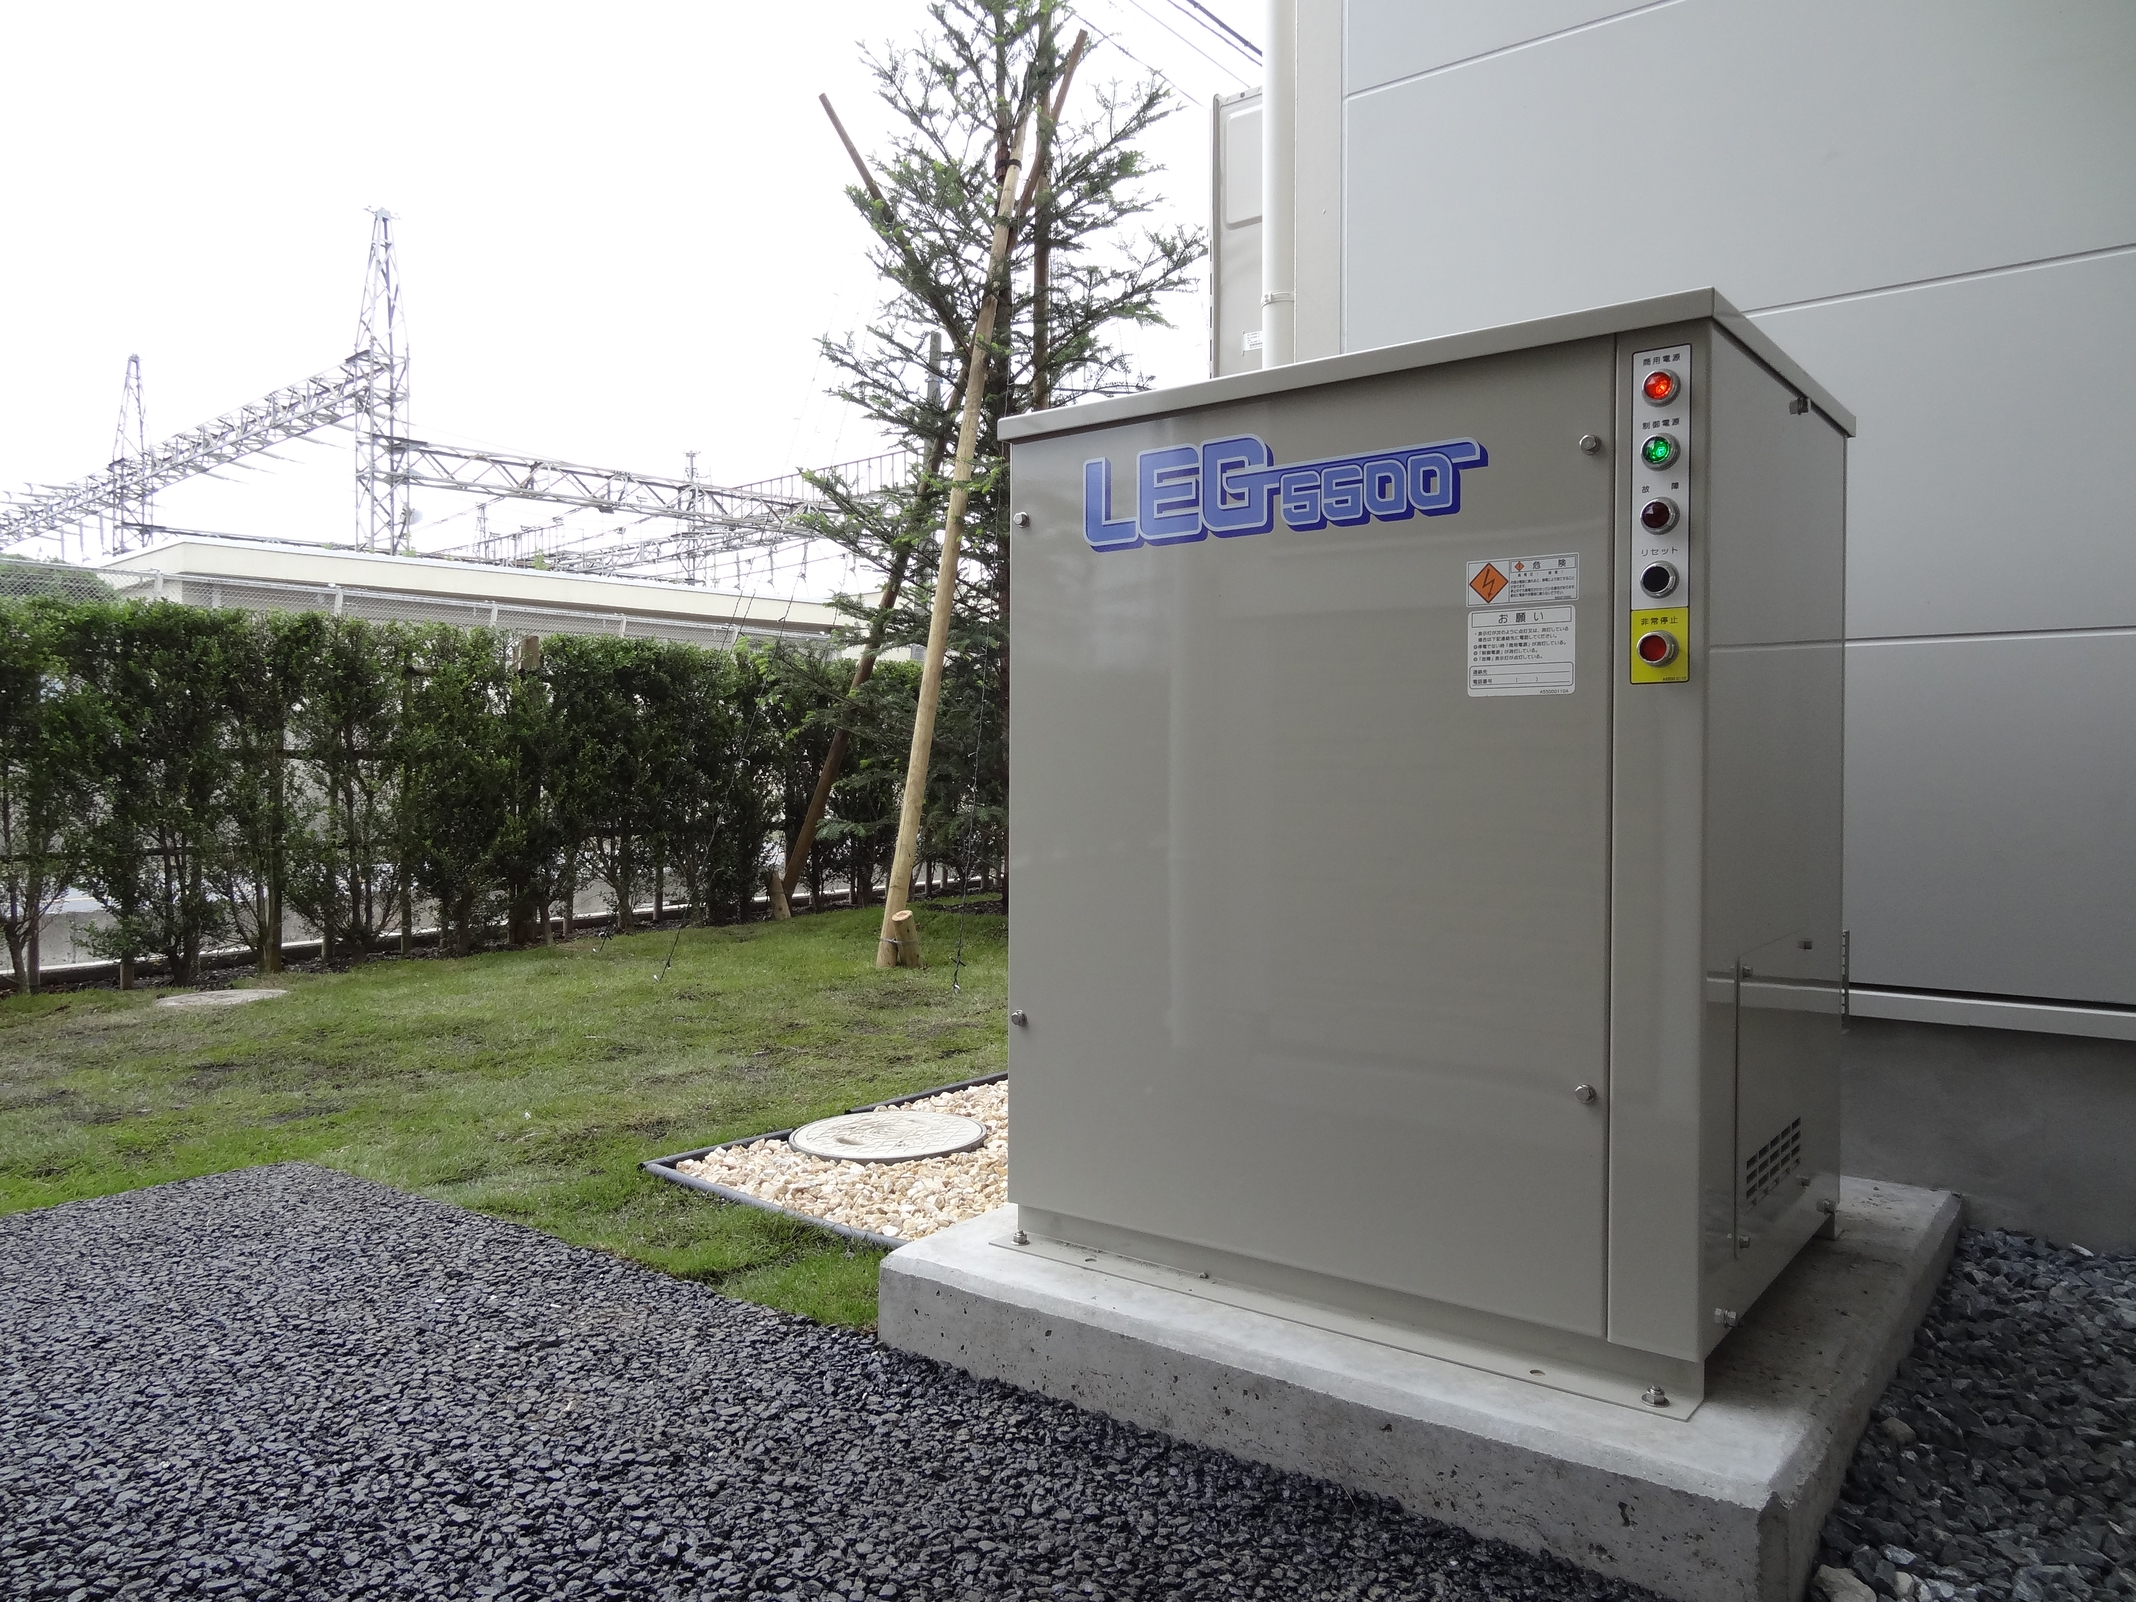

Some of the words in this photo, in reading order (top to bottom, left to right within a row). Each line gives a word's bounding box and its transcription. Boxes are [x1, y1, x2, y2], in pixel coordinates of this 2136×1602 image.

[1642, 353, 1681, 366] 商用電源
[1642, 417, 1680, 430] 制御電源
[1641, 546, 1678, 557] リセット
[1498, 612, 1544, 624] お願い
[1641, 616, 1679, 626] 非常停止
